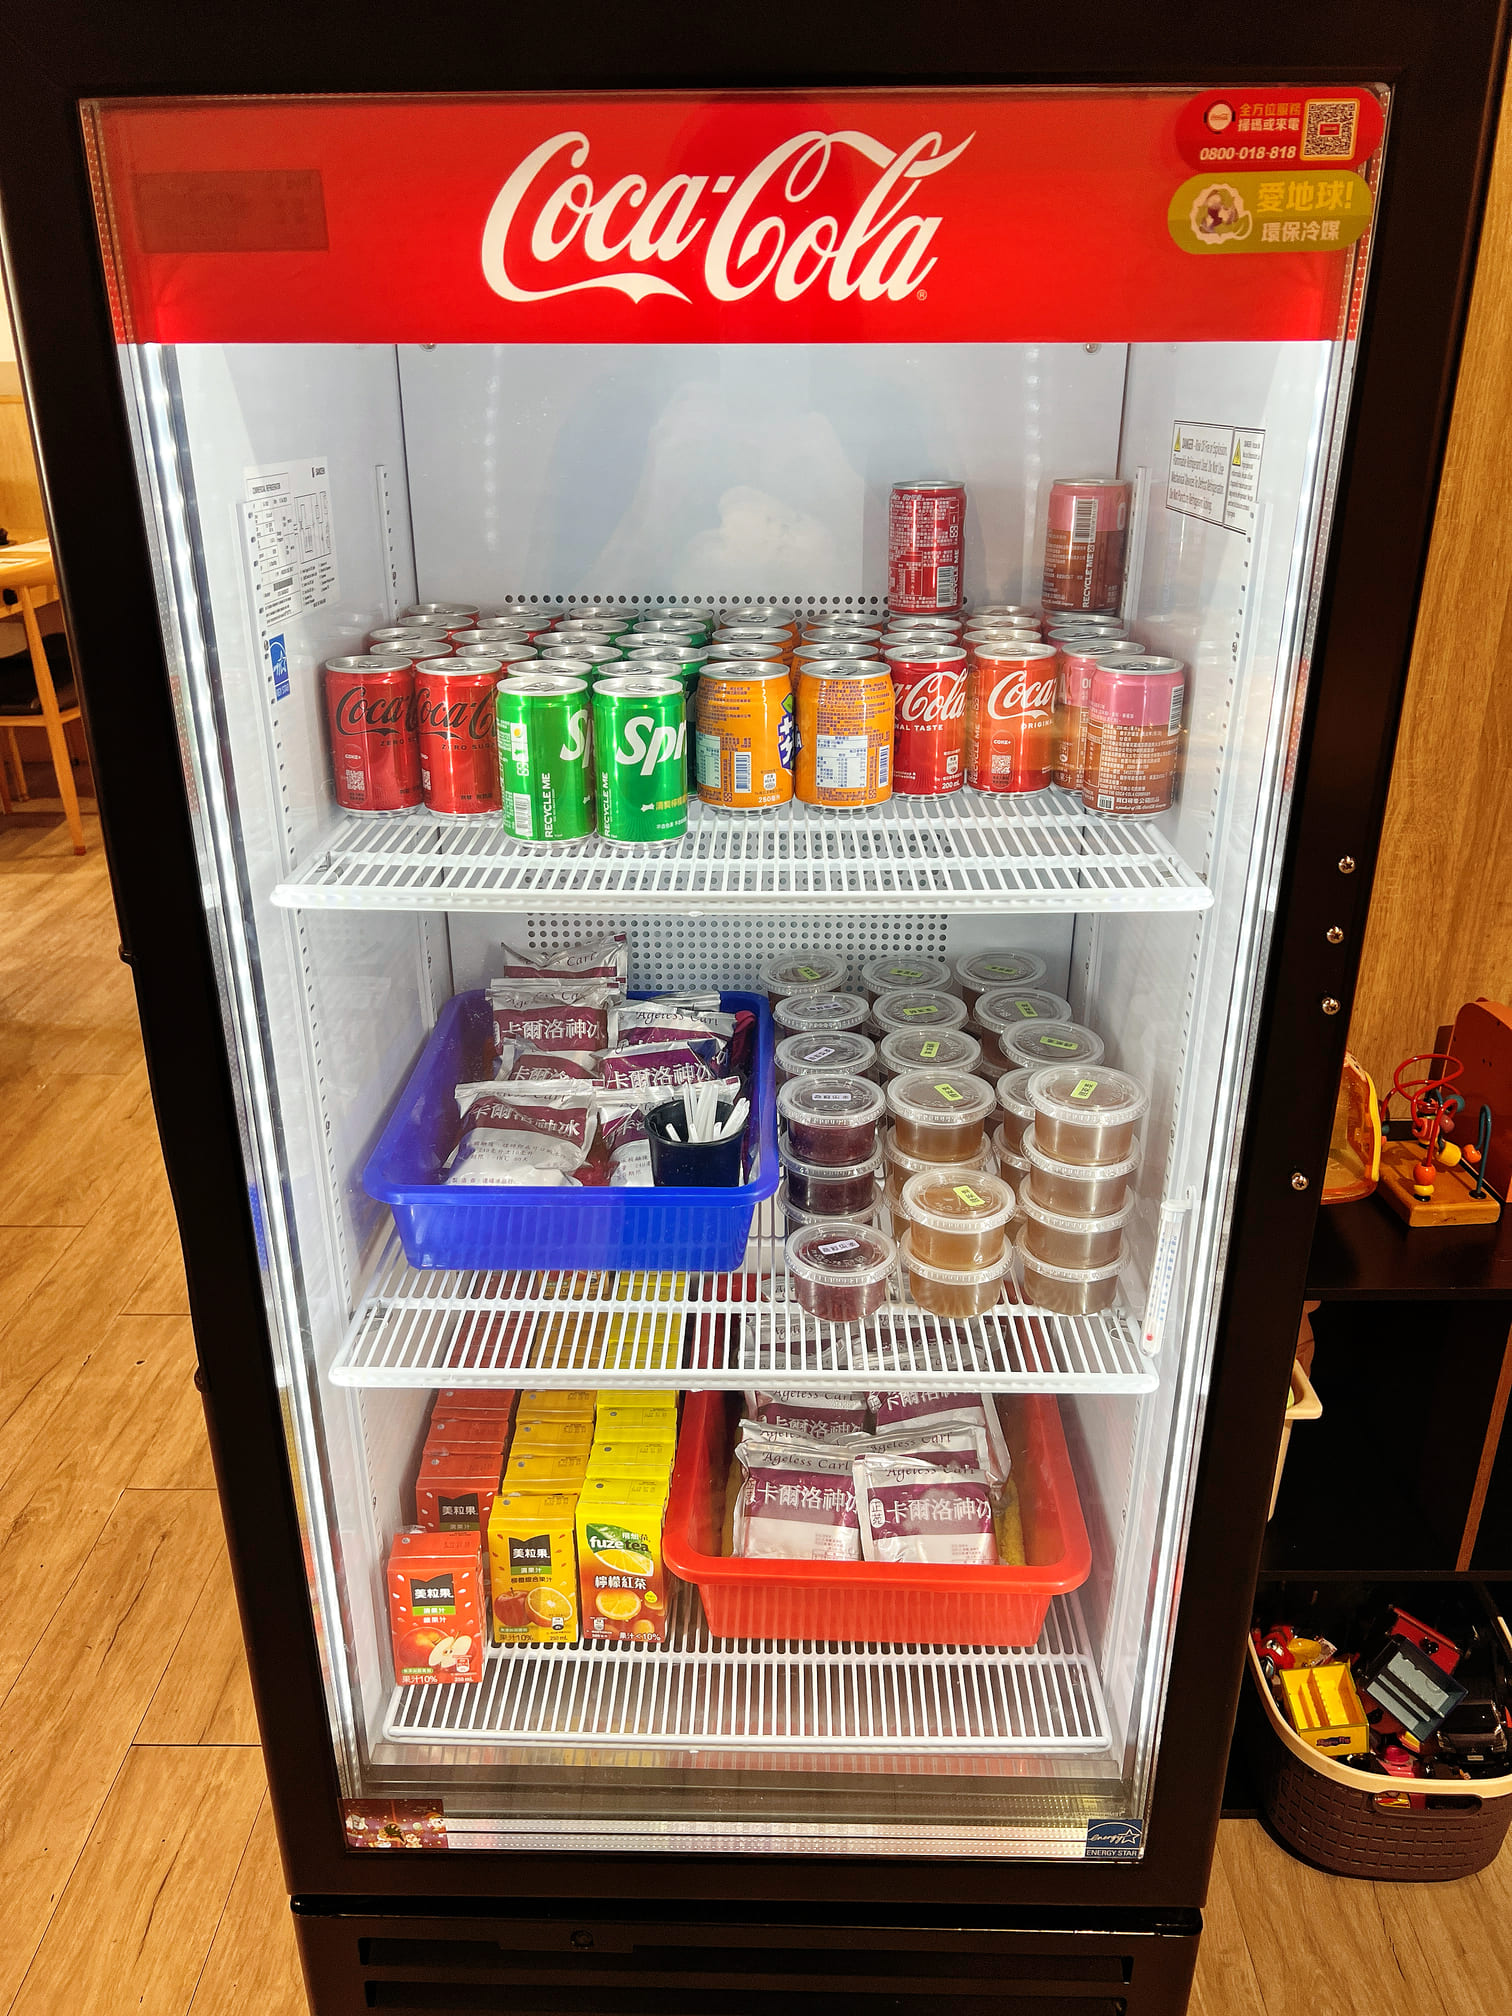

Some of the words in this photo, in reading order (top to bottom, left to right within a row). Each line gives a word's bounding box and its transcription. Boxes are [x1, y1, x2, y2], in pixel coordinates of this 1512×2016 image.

[1200, 146, 1297, 160] 0800-018-818
[1257, 181, 1354, 212] 愛地球!
[481, 130, 977, 304] Coca-Cola
[1261, 221, 1342, 242] 環保冷媒
[1086, 553, 1094, 567] ME
[1082, 568, 1093, 608] RECYCLE
[914, 724, 944, 732] TASTE
[615, 715, 687, 776] Spr
[541, 772, 551, 790] ME
[602, 771, 609, 789] ME
[543, 790, 554, 838] RECYCLE
[603, 788, 612, 838] RECYCLE
[761, 1451, 812, 1467] Ageless
[818, 1459, 849, 1471] Carl
[442, 1505, 478, 1516] 美粒果
[512, 1548, 550, 1559] 美粒果
[594, 1575, 647, 1590] 檸檬紅茶
[414, 1588, 450, 1599] 美粒果
[402, 1675, 438, 1684] 果汁10%
